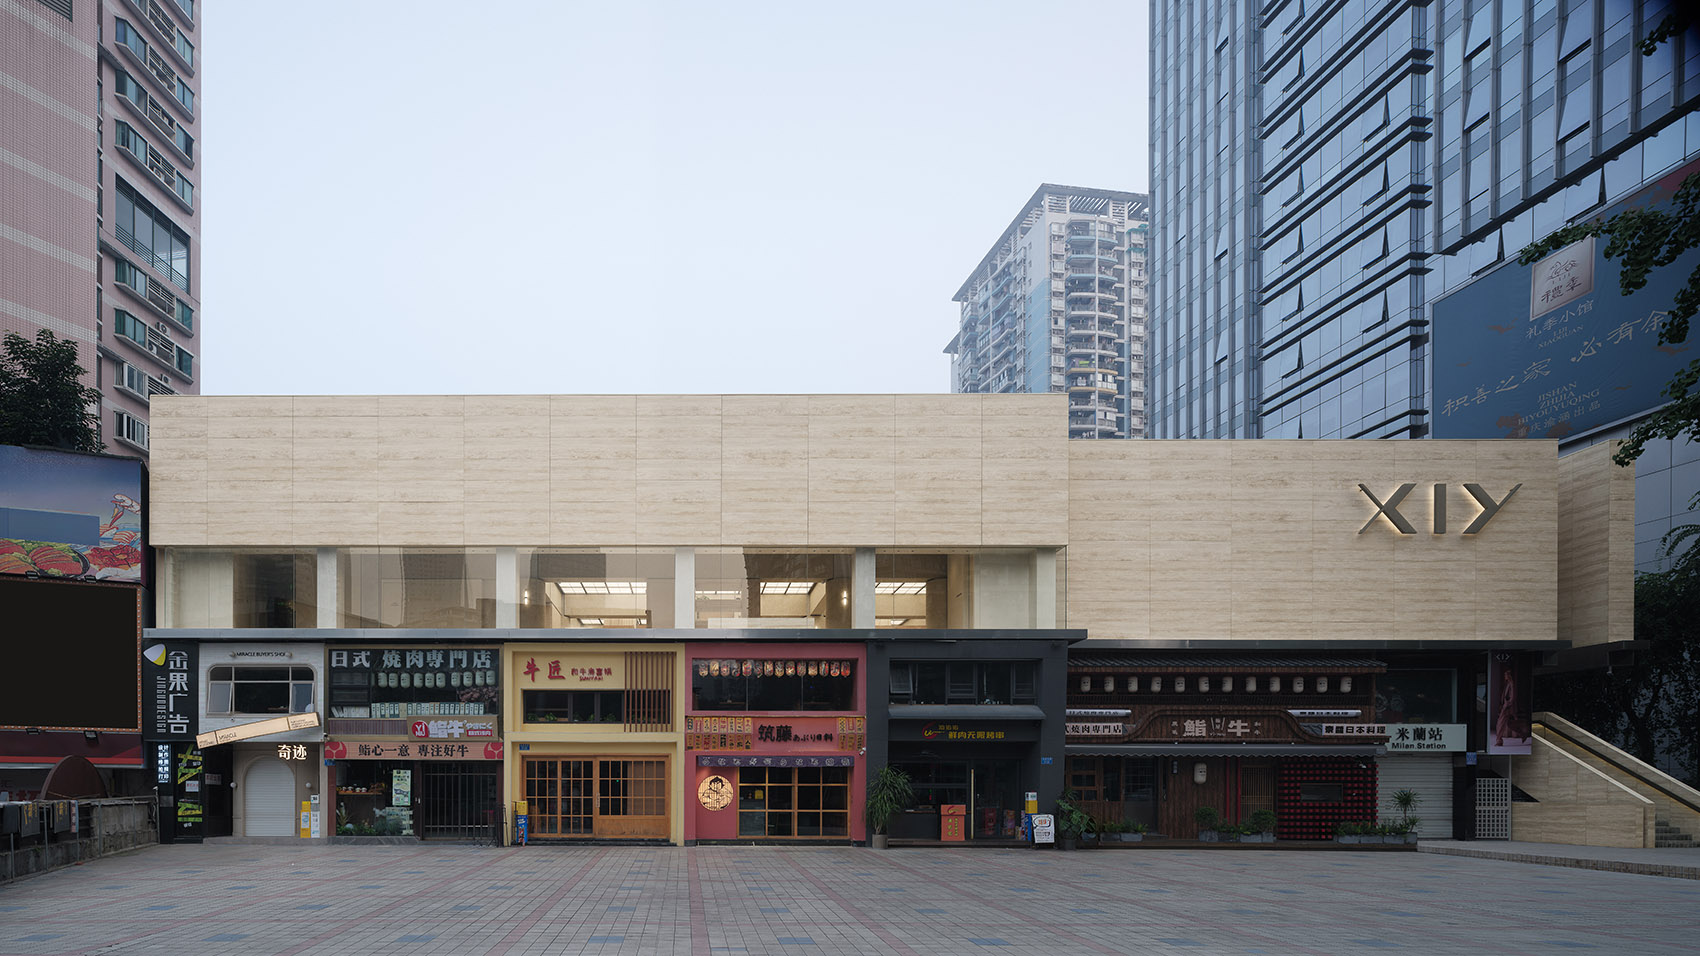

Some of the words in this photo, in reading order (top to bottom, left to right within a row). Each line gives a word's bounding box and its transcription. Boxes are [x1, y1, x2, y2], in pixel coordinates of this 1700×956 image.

[1525, 299, 1594, 340] 礼季小馆
[1441, 358, 1551, 417] 积善之家
[1536, 381, 1577, 403] JISHAN
[1540, 391, 1575, 409] ZHIJIA
[1358, 483, 1523, 535] XIY
[523, 656, 566, 683] 牛匠
[167, 650, 190, 734] 金果广告
[758, 724, 792, 742] 筑藤
[1227, 719, 1250, 737] 牛
[1395, 726, 1443, 741] 米蘭站
[278, 744, 307, 760] 奇迹
[358, 744, 410, 757] 鮨心一意
[1417, 742, 1447, 750] Station
